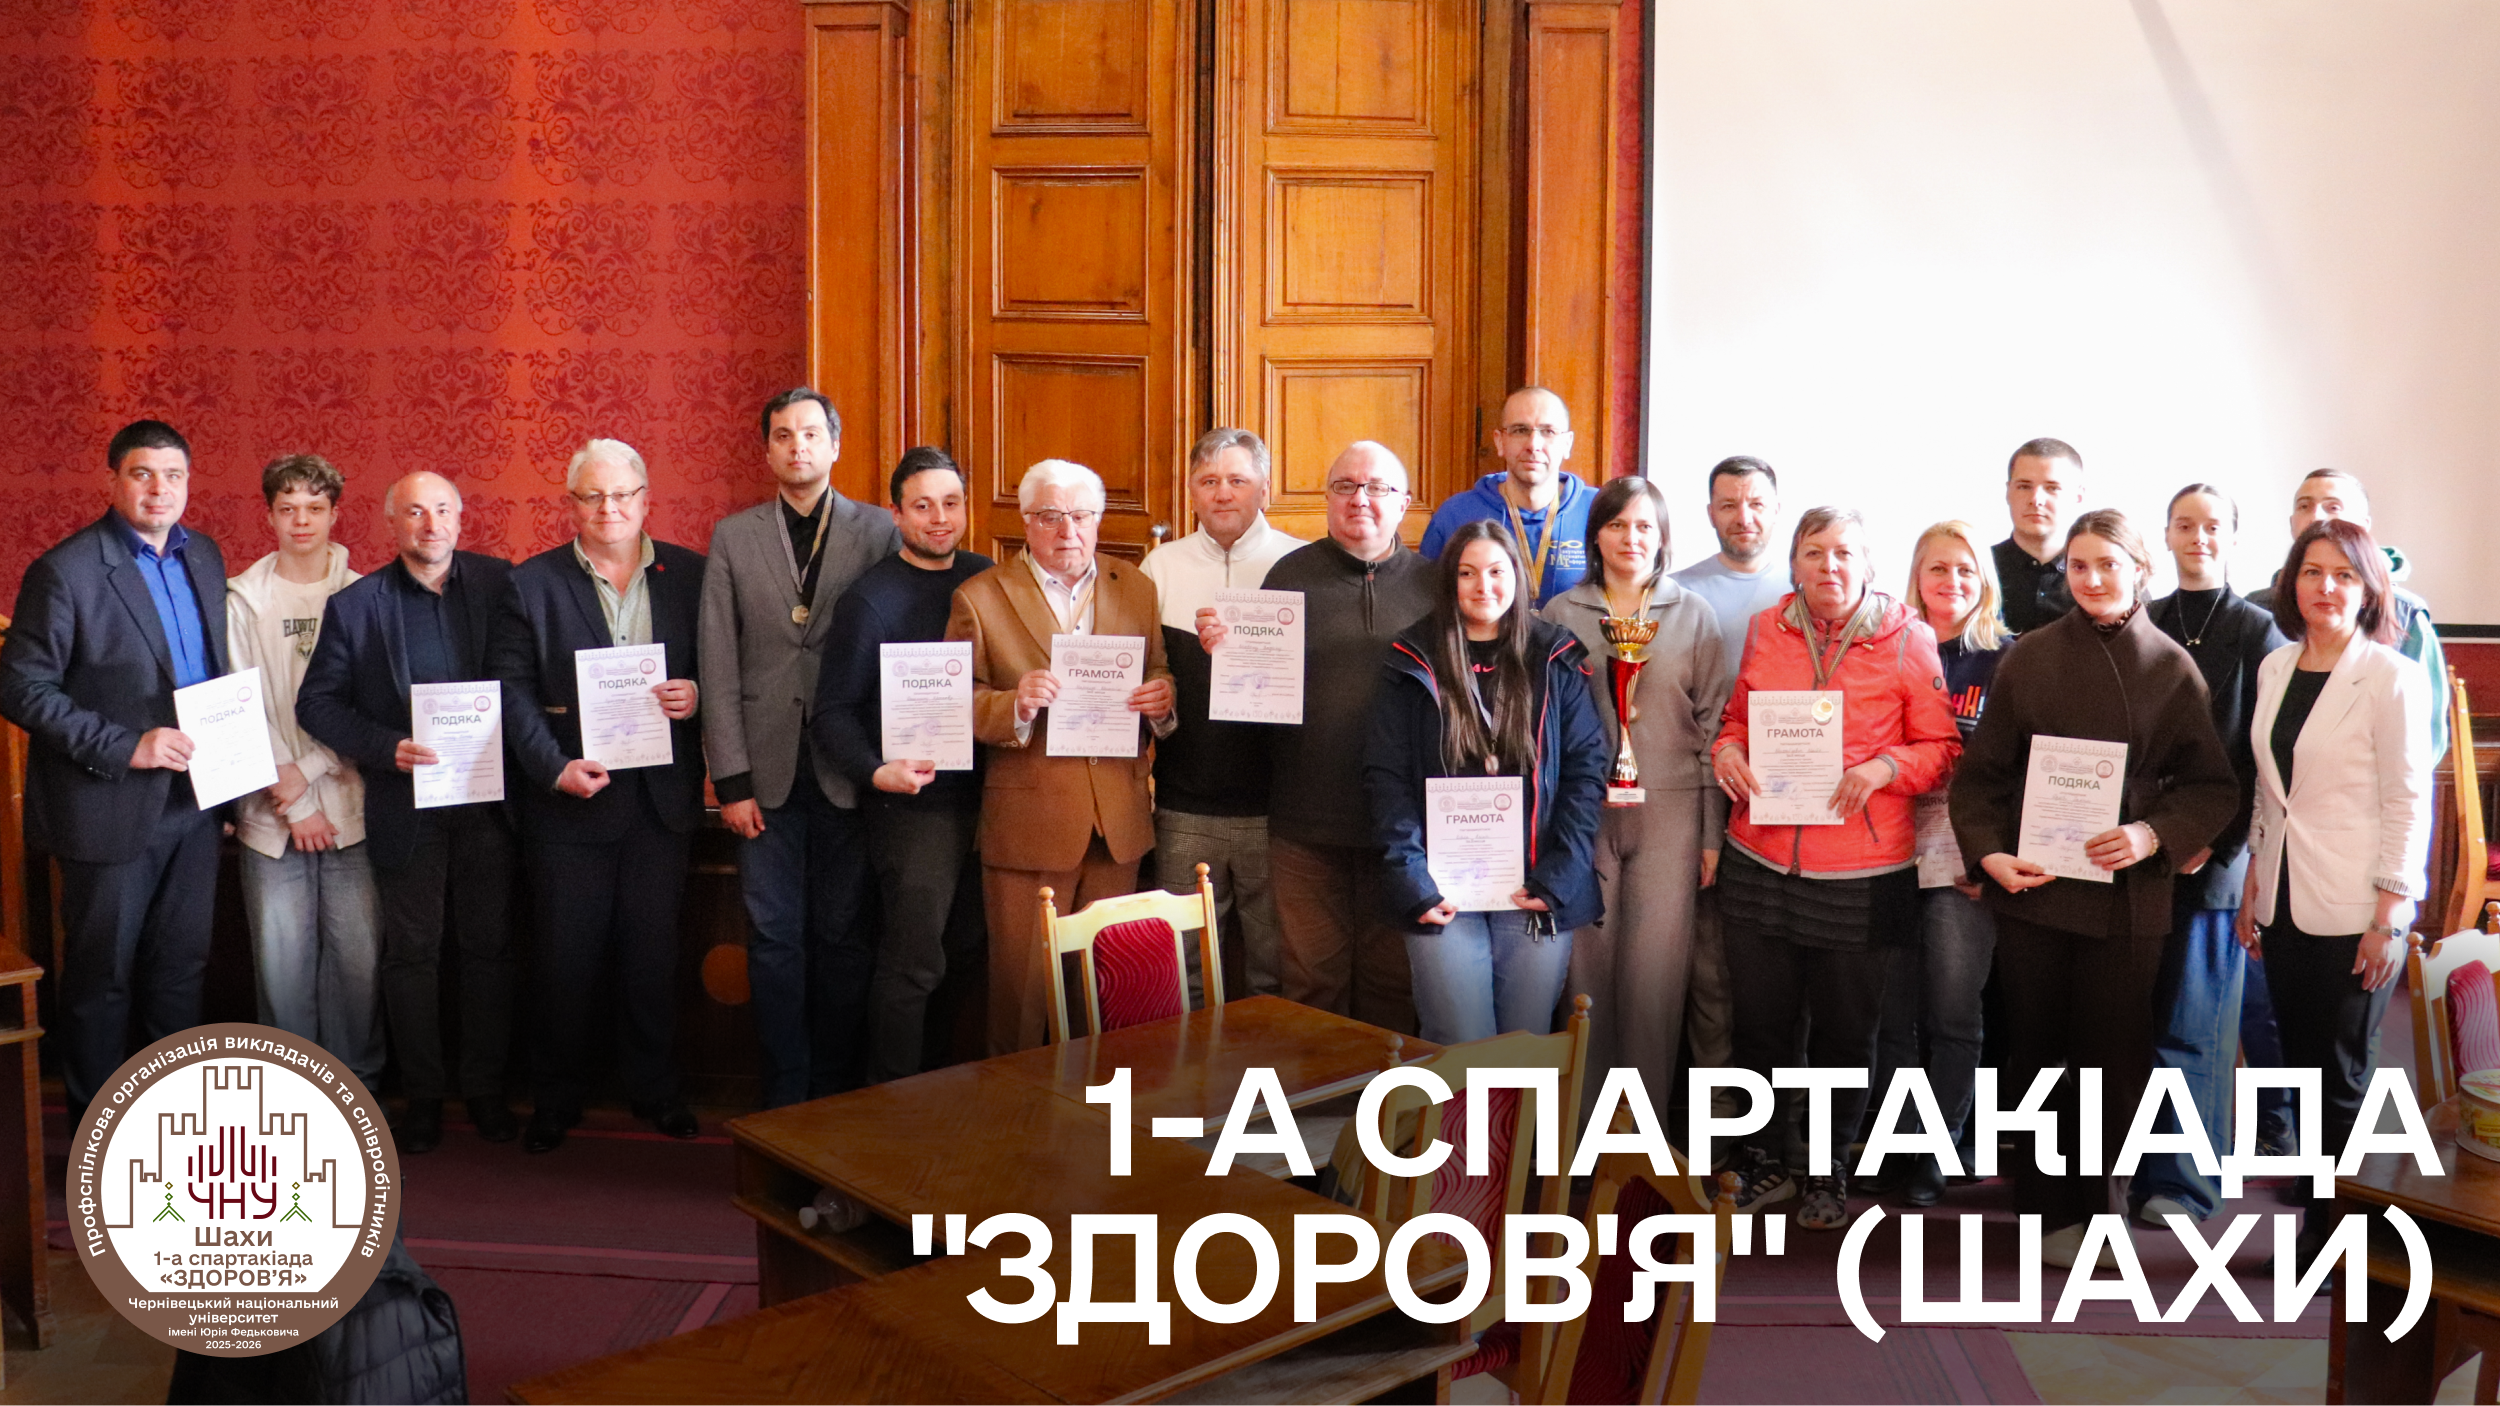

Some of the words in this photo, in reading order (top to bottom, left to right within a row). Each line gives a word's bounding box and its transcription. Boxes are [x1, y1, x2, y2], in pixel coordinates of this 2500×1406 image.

[1233, 625, 1285, 637] ПОДЯКА
[1068, 668, 1125, 680] ГРАМОТА
[598, 677, 648, 690] ПОДЯКА
[902, 678, 953, 690] ПОДЯКА
[199, 705, 246, 726] ПОДЯКА
[432, 714, 482, 726] ПОДЯКА
[1767, 728, 1824, 738] ГРАМОТА
[2048, 775, 2101, 790] ПОДЯКА
[1446, 813, 1505, 825] ГРАМОТА
